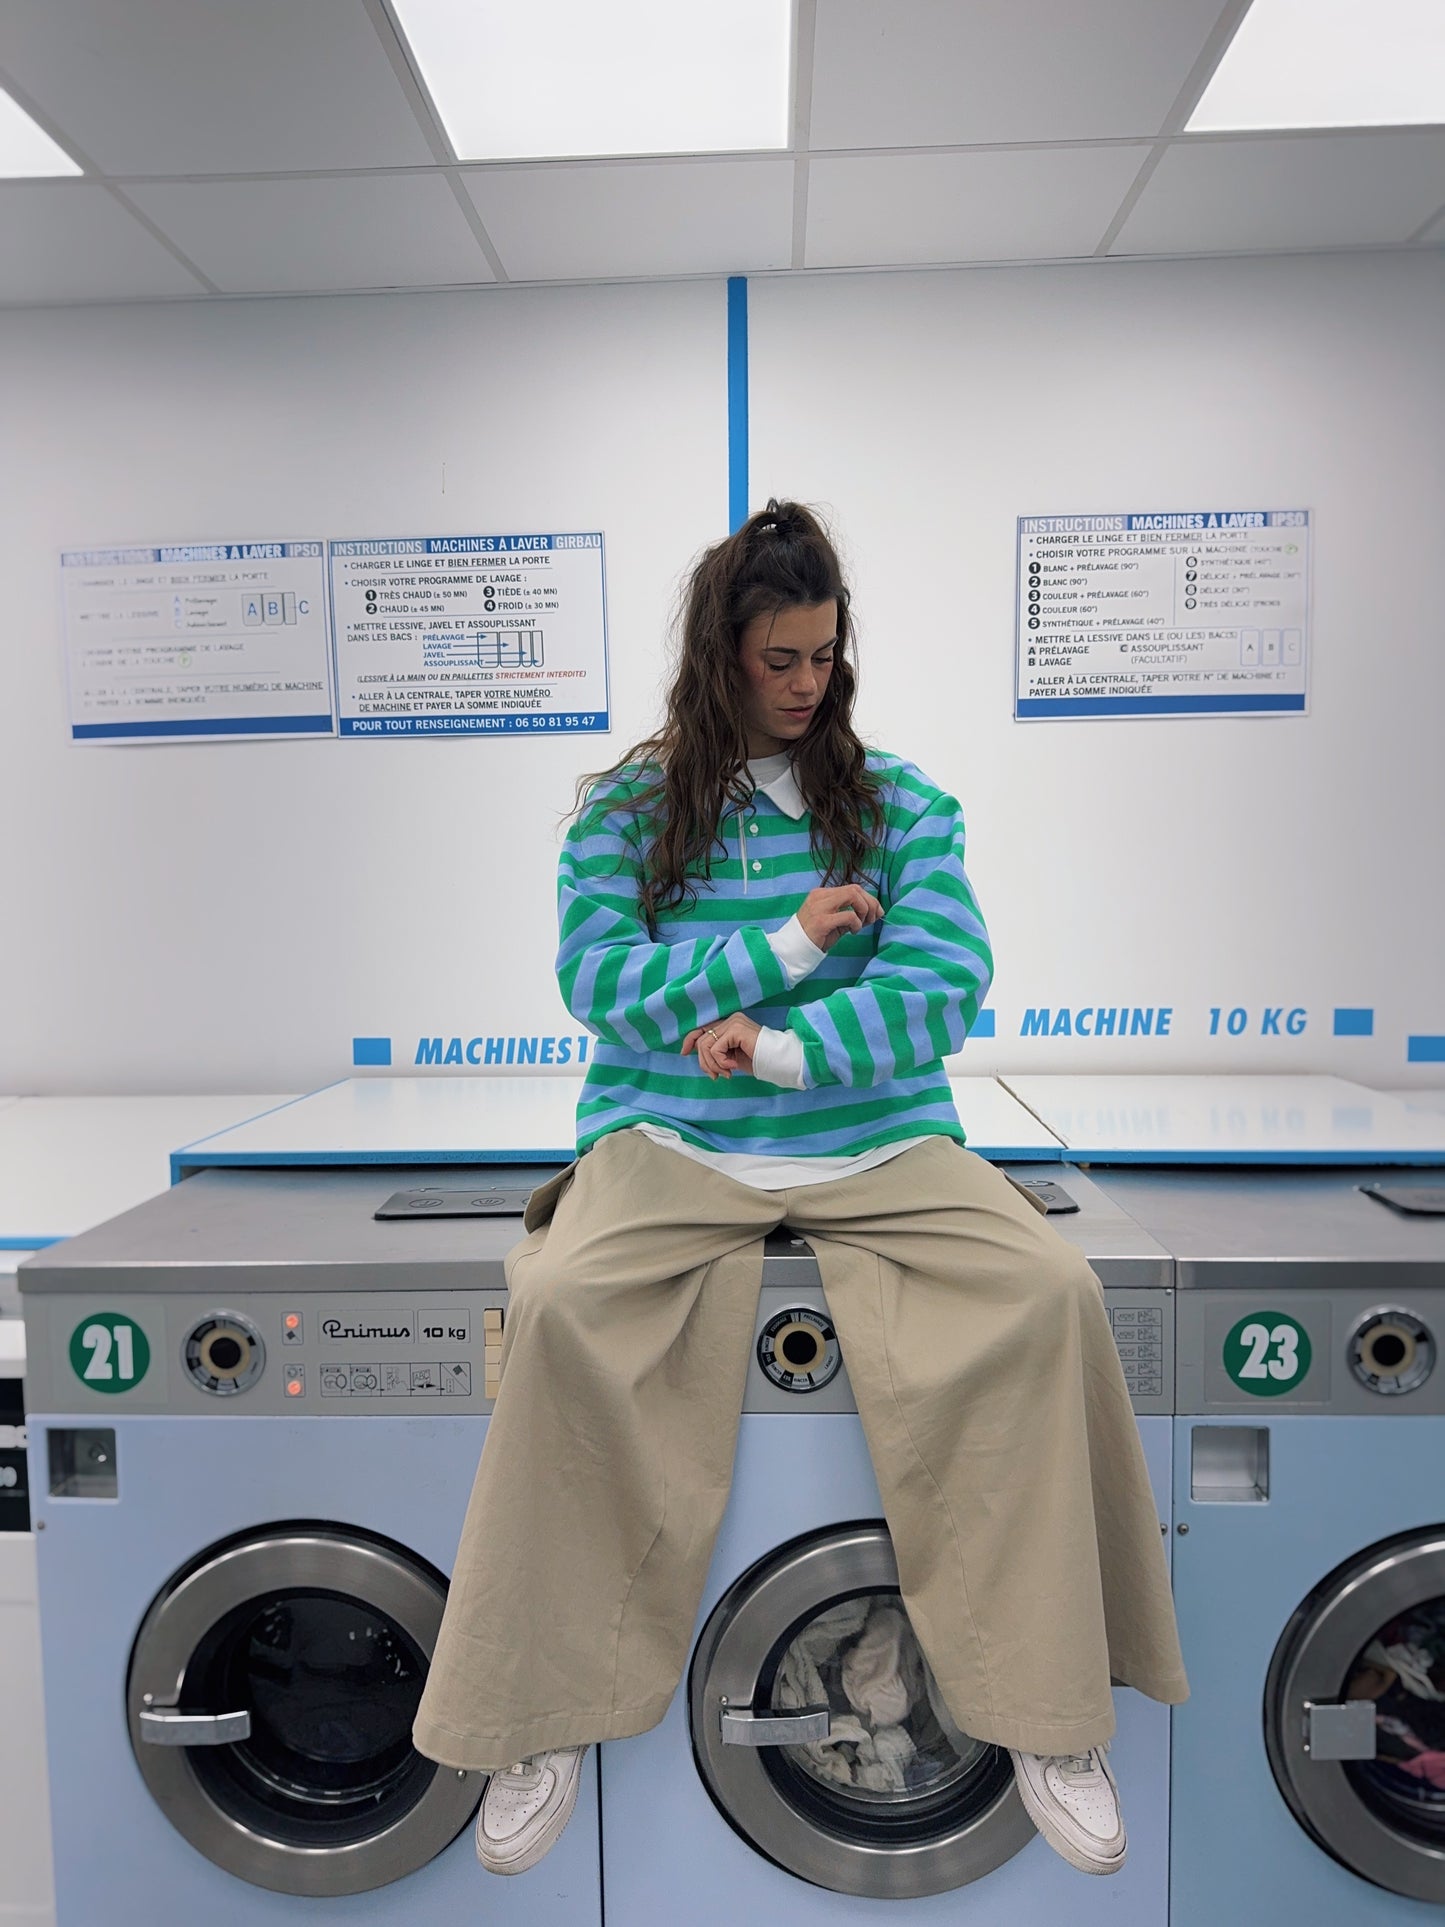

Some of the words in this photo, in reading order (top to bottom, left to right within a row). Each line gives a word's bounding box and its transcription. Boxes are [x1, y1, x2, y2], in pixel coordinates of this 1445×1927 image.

[1024, 518, 1122, 532] INSTRUCTIONS
[1132, 514, 1204, 530] MACHINES
[1222, 513, 1264, 527] LAVER
[1272, 512, 1305, 526] IPSO
[1036, 536, 1079, 544] CHARGER
[1083, 535, 1093, 543] LE
[1127, 534, 1137, 542] ET
[1141, 534, 1162, 542] BIEN
[243, 544, 282, 559] LAVER
[290, 543, 319, 557] IPSO
[335, 541, 422, 555] INSTRUCTIONS
[431, 538, 494, 552] MACHINES
[511, 537, 548, 550] LAVER
[1036, 550, 1073, 558] CHOISIR
[1076, 549, 1105, 557] VOTRE
[1109, 548, 1165, 556] PROGRAMME
[351, 561, 390, 570] CHARGER
[394, 560, 404, 568] LE
[407, 560, 432, 568] LINGE
[435, 559, 445, 567] ET
[448, 558, 468, 567] BIEN
[472, 558, 506, 566] FERMER
[522, 556, 550, 564] PORTE
[1077, 563, 1118, 571] PRÉLAVAGE
[351, 578, 386, 587] CHOISIR
[419, 576, 473, 584] PROGRAMME
[476, 575, 487, 583] DE
[490, 574, 521, 582] LAVAGE
[380, 591, 400, 599] TRÈS
[403, 591, 431, 599] CHAUD
[497, 587, 521, 596] TIÈDE
[248, 602, 257, 616] A
[268, 602, 278, 615] B
[299, 600, 309, 614] C
[380, 605, 408, 613] CHAUD
[498, 602, 523, 610] FROID
[1042, 606, 1077, 614] COULEUR
[389, 622, 426, 630] LESSIVE,
[429, 621, 452, 629] JAVEL
[468, 619, 536, 628] ASSOUPLISSANT
[1042, 620, 1093, 628] SYNTHÉTIQUE
[1103, 618, 1144, 626] PRÉLAVAGE
[348, 634, 369, 642] DANS
[1035, 636, 1071, 644] METTRE
[1088, 634, 1123, 642] LESSIVE
[1153, 632, 1164, 641] LE
[1039, 646, 1089, 654] PRÉLAVAGE
[1131, 643, 1204, 653] ASSOUPLISSANT
[423, 659, 485, 667] ASSOUPLISSANT
[1028, 658, 1035, 666] B
[1039, 658, 1072, 666] LAVAGE
[1068, 674, 1073, 684] À
[1076, 676, 1087, 684] LA
[1090, 675, 1138, 684] CENTRALE,
[1142, 674, 1169, 682] TAPER
[1173, 673, 1200, 681] VOTRE
[285, 682, 323, 690] MACHINE
[1030, 688, 1056, 696] PAYER
[1073, 687, 1106, 695] SOMME
[1109, 685, 1152, 694] INDIQUÉE
[387, 691, 392, 699] À
[407, 691, 452, 699] CENTRALE,
[455, 690, 482, 699] TAPER
[484, 690, 511, 698] VOTRE
[514, 688, 550, 697] NUMÉRO
[373, 703, 411, 711] MACHINE
[426, 702, 451, 710] PAYER
[454, 701, 464, 709] LA
[502, 700, 541, 708] INDIQUÉE
[353, 721, 381, 730] POUR
[385, 721, 412, 730] TOUT
[415, 718, 506, 730] RENSEIGNEMENT
[515, 718, 528, 727] 06
[532, 718, 545, 727] 50
[549, 718, 561, 726] 81
[565, 717, 578, 726] 95
[582, 716, 595, 725] 47
[1020, 1008, 1173, 1036] MACHINE
[1209, 1008, 1248, 1036] 10
[1261, 1008, 1307, 1036] KG
[323, 1319, 410, 1338] Primus
[423, 1328, 443, 1338] 10
[449, 1327, 466, 1340] kg
[82, 1324, 134, 1379] 21
[1238, 1323, 1299, 1380] 23
